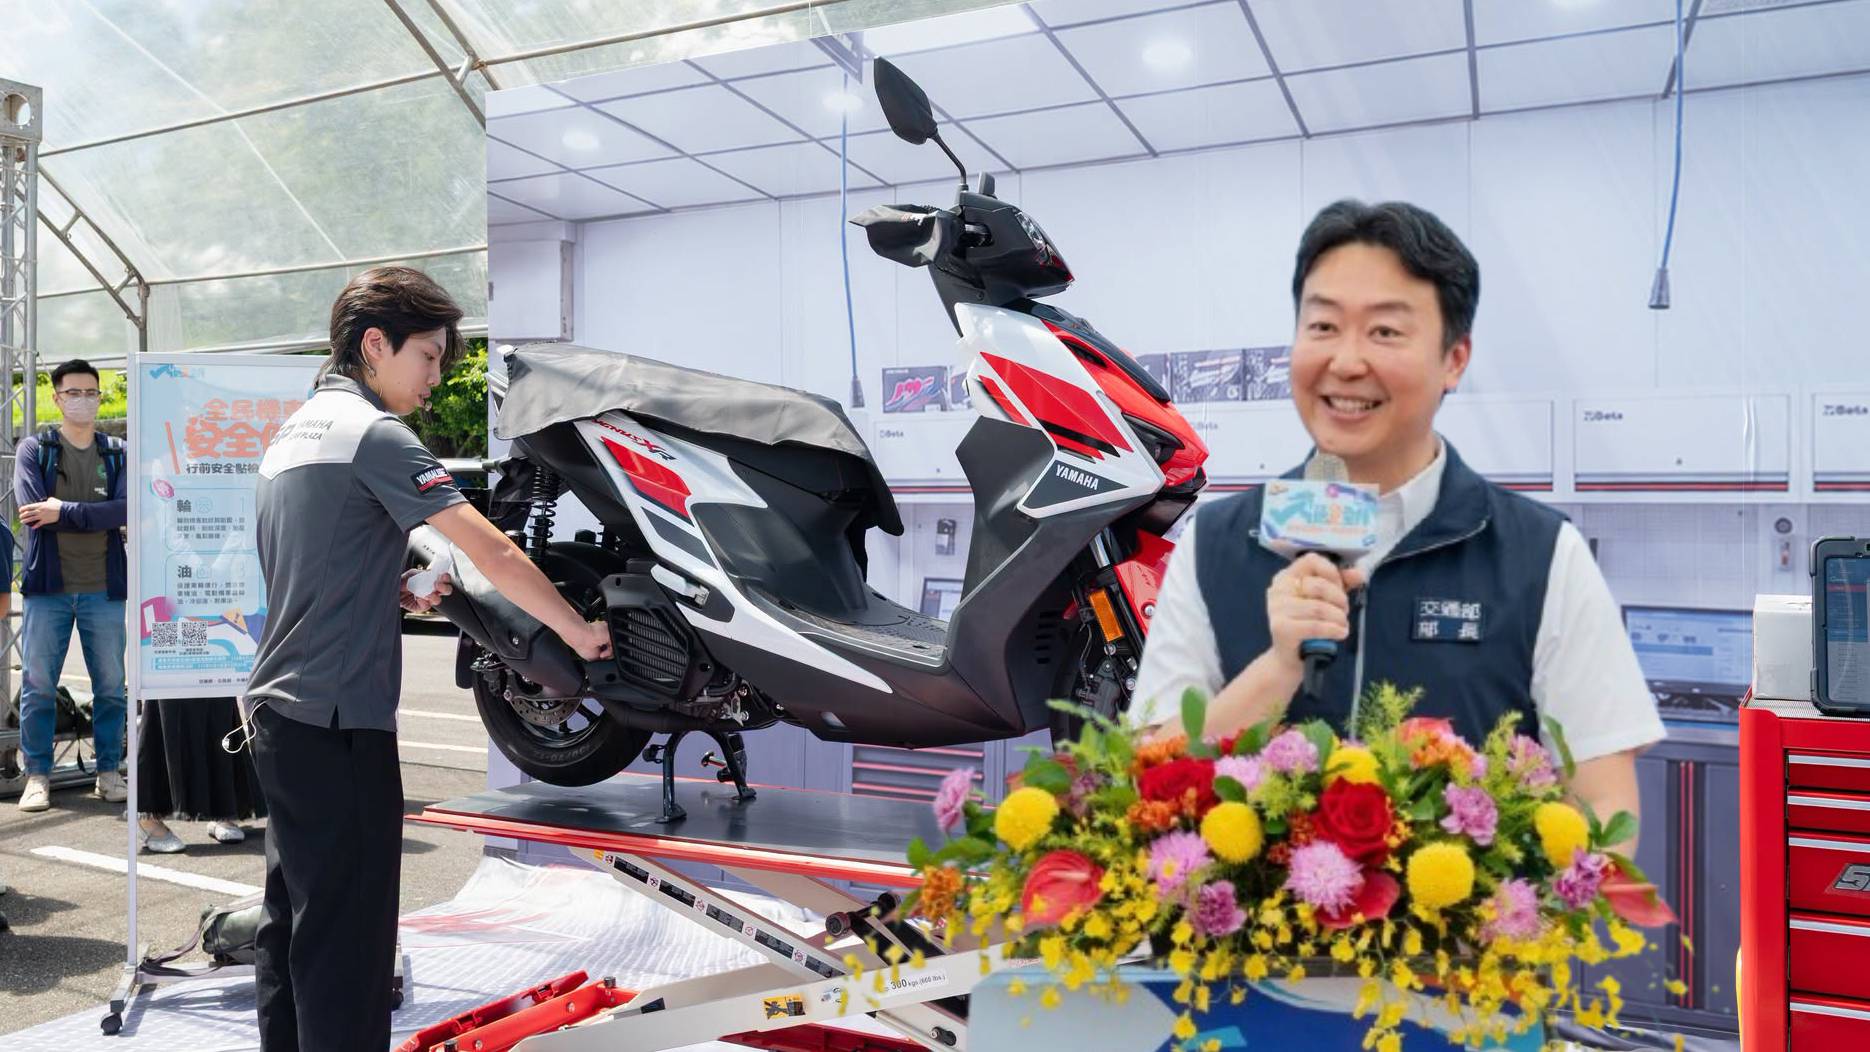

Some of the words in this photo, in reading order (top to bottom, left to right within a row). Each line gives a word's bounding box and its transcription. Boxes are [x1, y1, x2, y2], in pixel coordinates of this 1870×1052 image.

[1056, 464, 1099, 490] YAMAHA
[176, 499, 192, 513] 輪
[177, 565, 192, 579] 油
